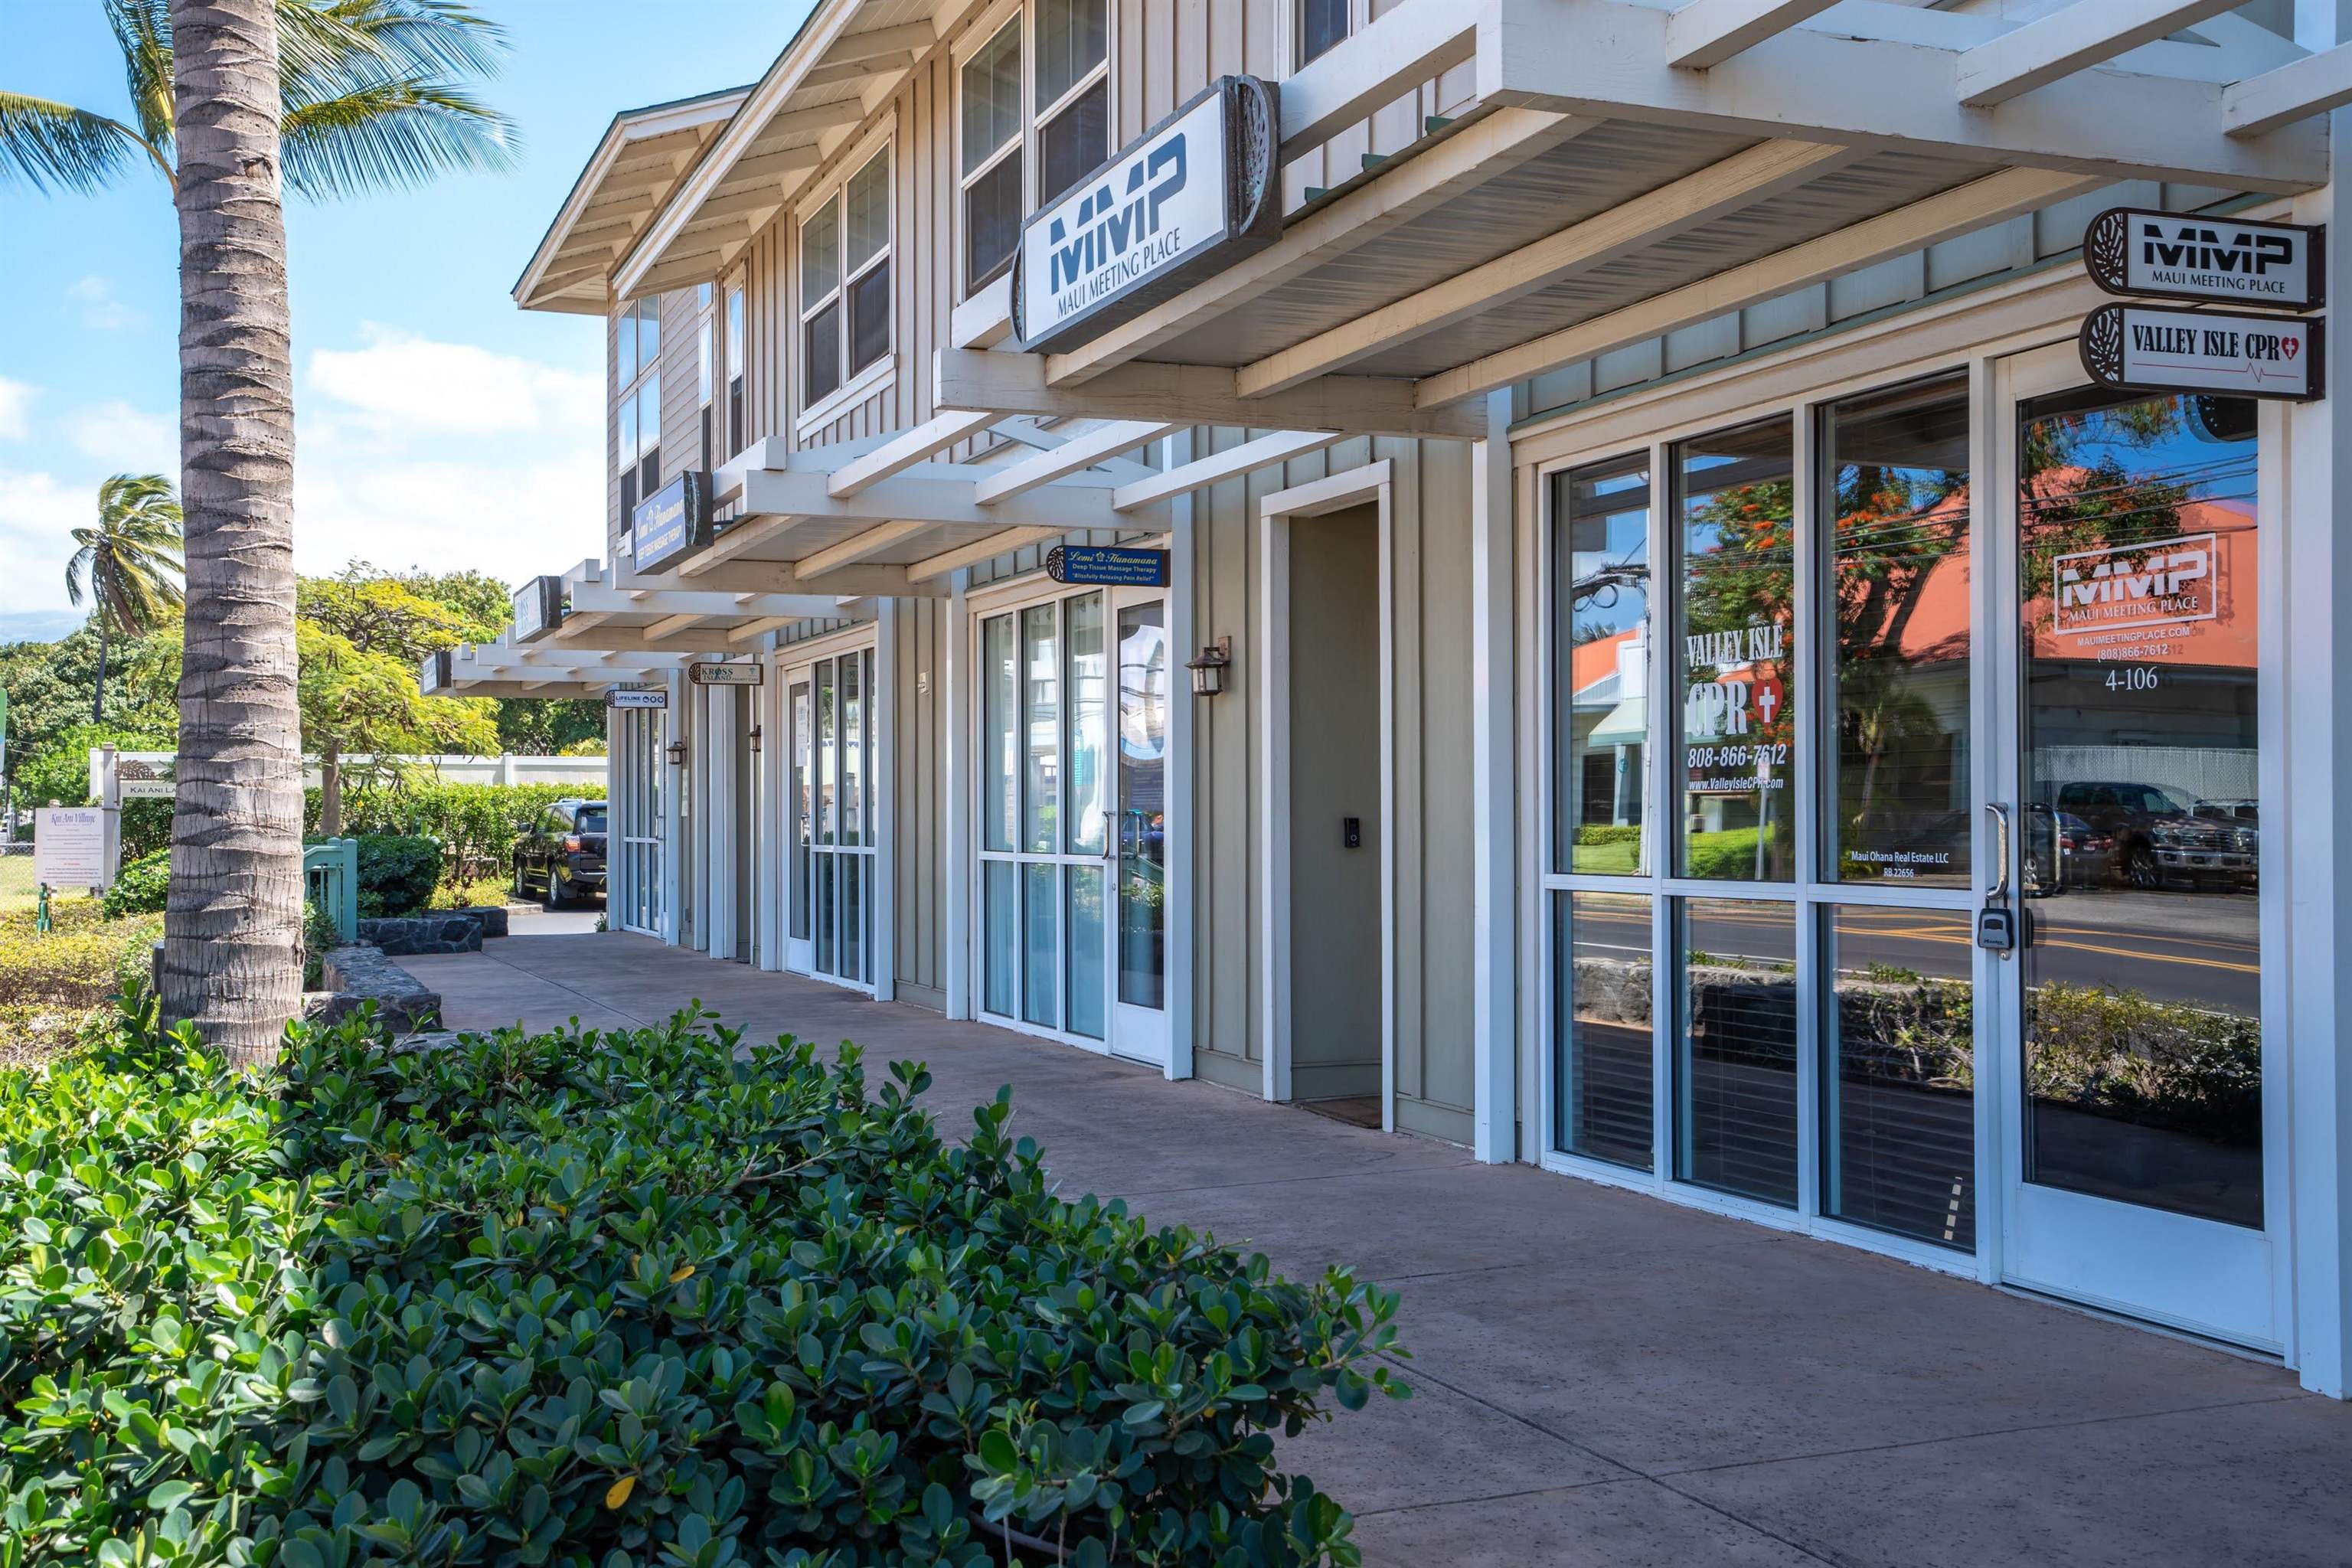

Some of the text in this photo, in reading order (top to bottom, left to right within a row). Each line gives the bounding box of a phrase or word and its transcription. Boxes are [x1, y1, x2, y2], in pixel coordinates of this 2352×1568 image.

[1050, 132, 1187, 296] MMP
[2144, 224, 2292, 275] MMP
[1057, 227, 1181, 319] MAUI MEETING PLACE
[2152, 270, 2285, 294] MAUI MEETING PLACE
[2132, 325, 2280, 361] VALLEY ISLE CPR
[2063, 550, 2208, 607] MMP
[2069, 596, 2198, 622] MAUI MEETING PLACE
[1687, 625, 1783, 668] VALLEY ISLE
[2077, 627, 2190, 647] MAUIMEETINGPLACE.COM
[2097, 644, 2169, 663] (808)866-7612
[2105, 666, 2158, 691] 4-106
[1688, 679, 1748, 737] CPR
[1687, 743, 1787, 768] 808-866-7612
[1688, 776, 1784, 792] www.ValleyIsleCPR.com
[1851, 851, 1949, 864] Maui Ohana Real Estate LLC
[1883, 867, 1914, 877] RB 22656
